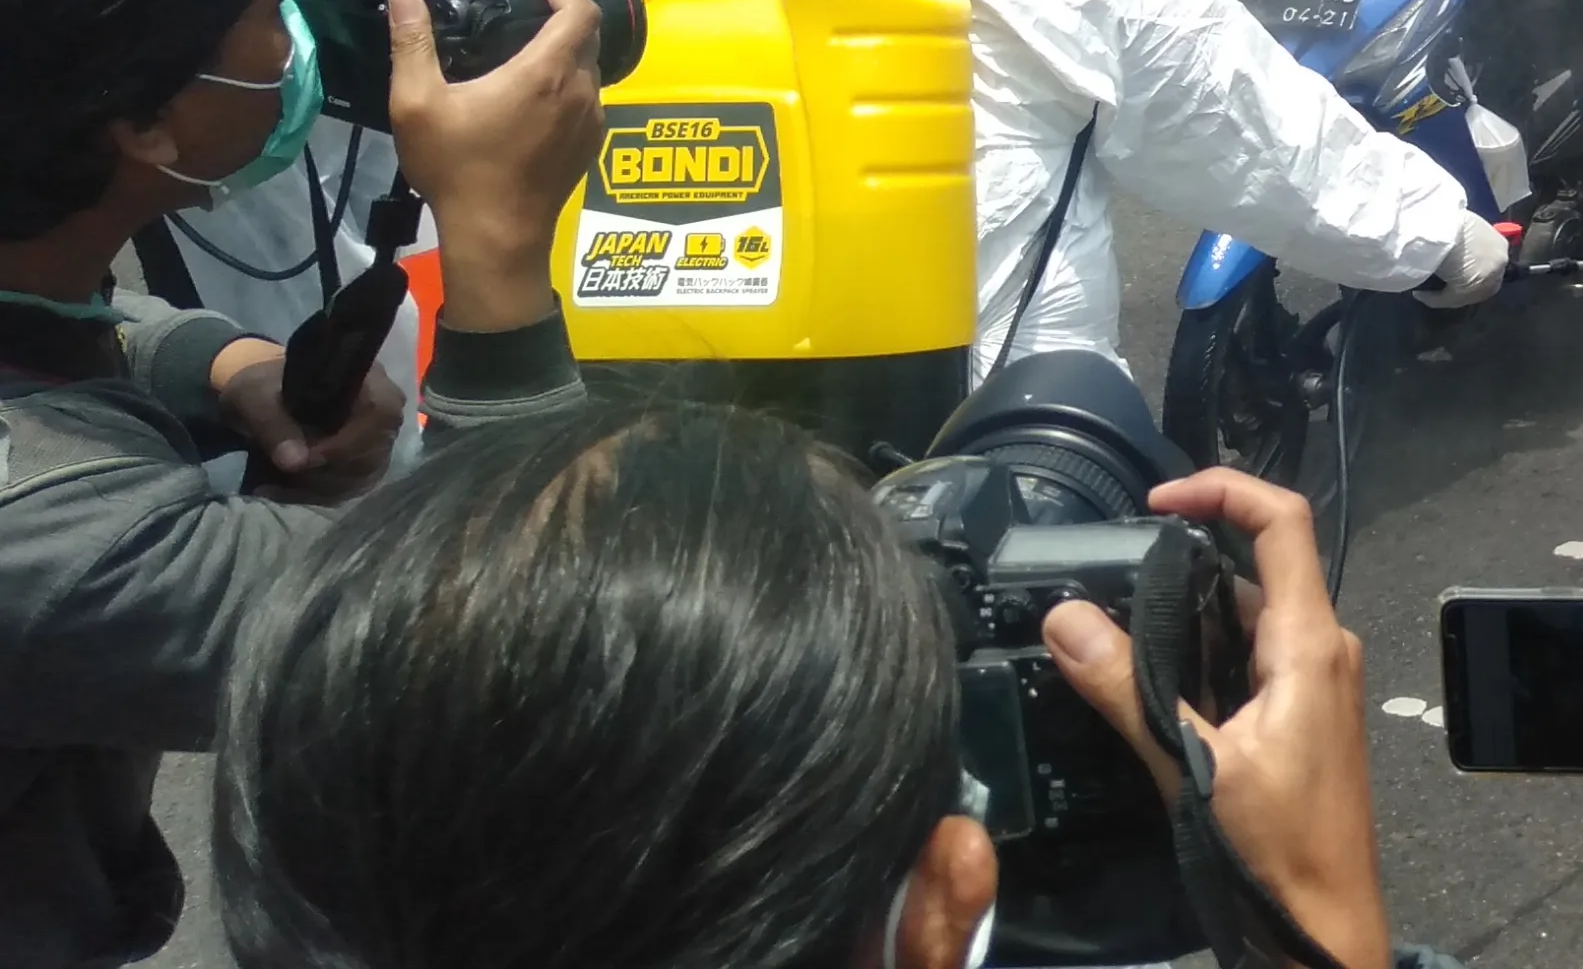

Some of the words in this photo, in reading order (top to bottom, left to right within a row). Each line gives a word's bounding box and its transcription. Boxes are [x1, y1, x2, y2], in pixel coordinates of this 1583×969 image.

[651, 121, 714, 139] BSE16
[611, 146, 754, 184] BONDI
[619, 192, 660, 200] AMERICAN
[662, 191, 690, 199] POWER
[693, 191, 744, 199] EQUIPMENT
[586, 232, 671, 261] JAPAN
[610, 255, 643, 268] TECH
[676, 257, 727, 268] ELECTRIC
[580, 266, 668, 292] 日本技術
